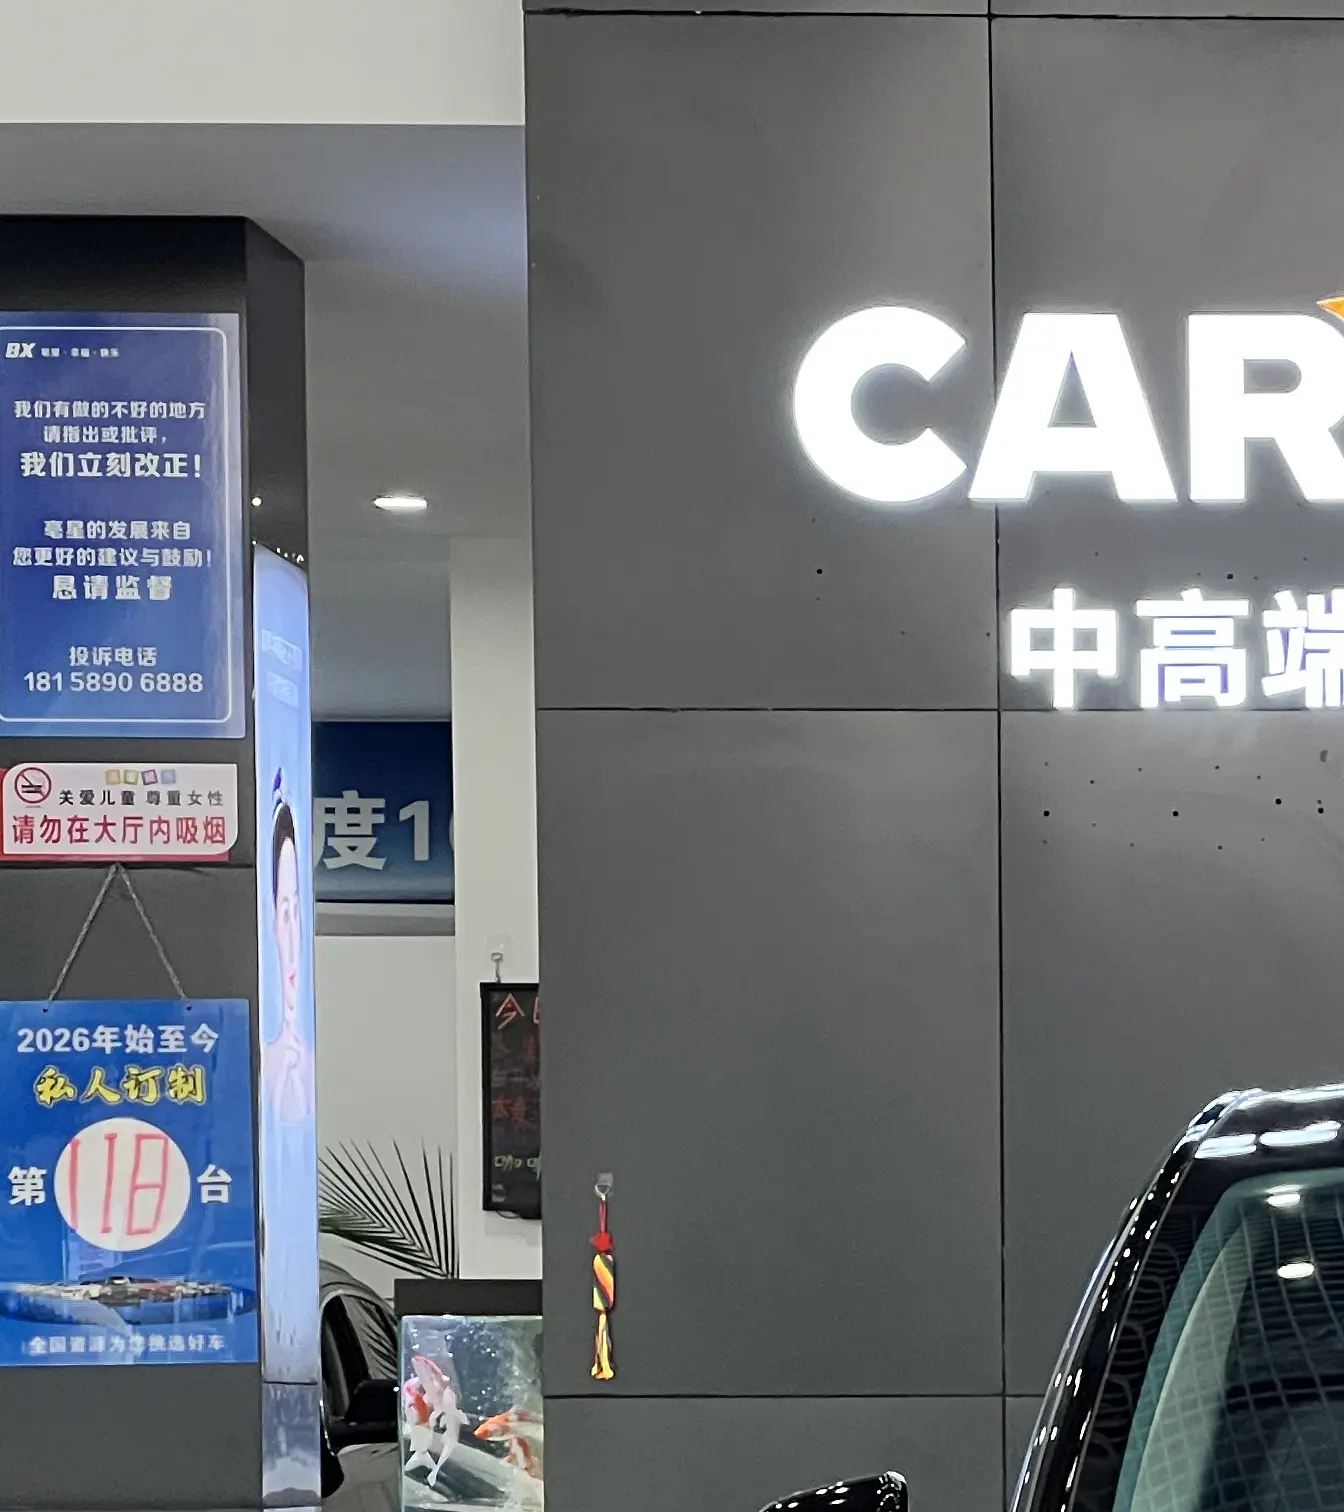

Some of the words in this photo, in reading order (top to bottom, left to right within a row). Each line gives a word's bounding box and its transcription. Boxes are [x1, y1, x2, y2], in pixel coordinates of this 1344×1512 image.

[14, 400, 206, 419] 我们有做的不好的地方
[20, 452, 202, 478] 我们立刻改正！
[52, 574, 173, 601] 恳请监督
[69, 645, 158, 667] 投诉电话
[23, 671, 63, 692] 181
[70, 671, 133, 693] 5890
[140, 672, 204, 693] 6888
[58, 788, 136, 807] 关爱儿童
[145, 788, 225, 807] 尊重女性
[12, 813, 227, 846] 请勿在大厅内吸烟
[17, 1022, 219, 1055] 2026年始至今
[33, 1065, 207, 1107] 私人订制
[8, 1165, 48, 1207] 第
[196, 1163, 233, 1205] 台
